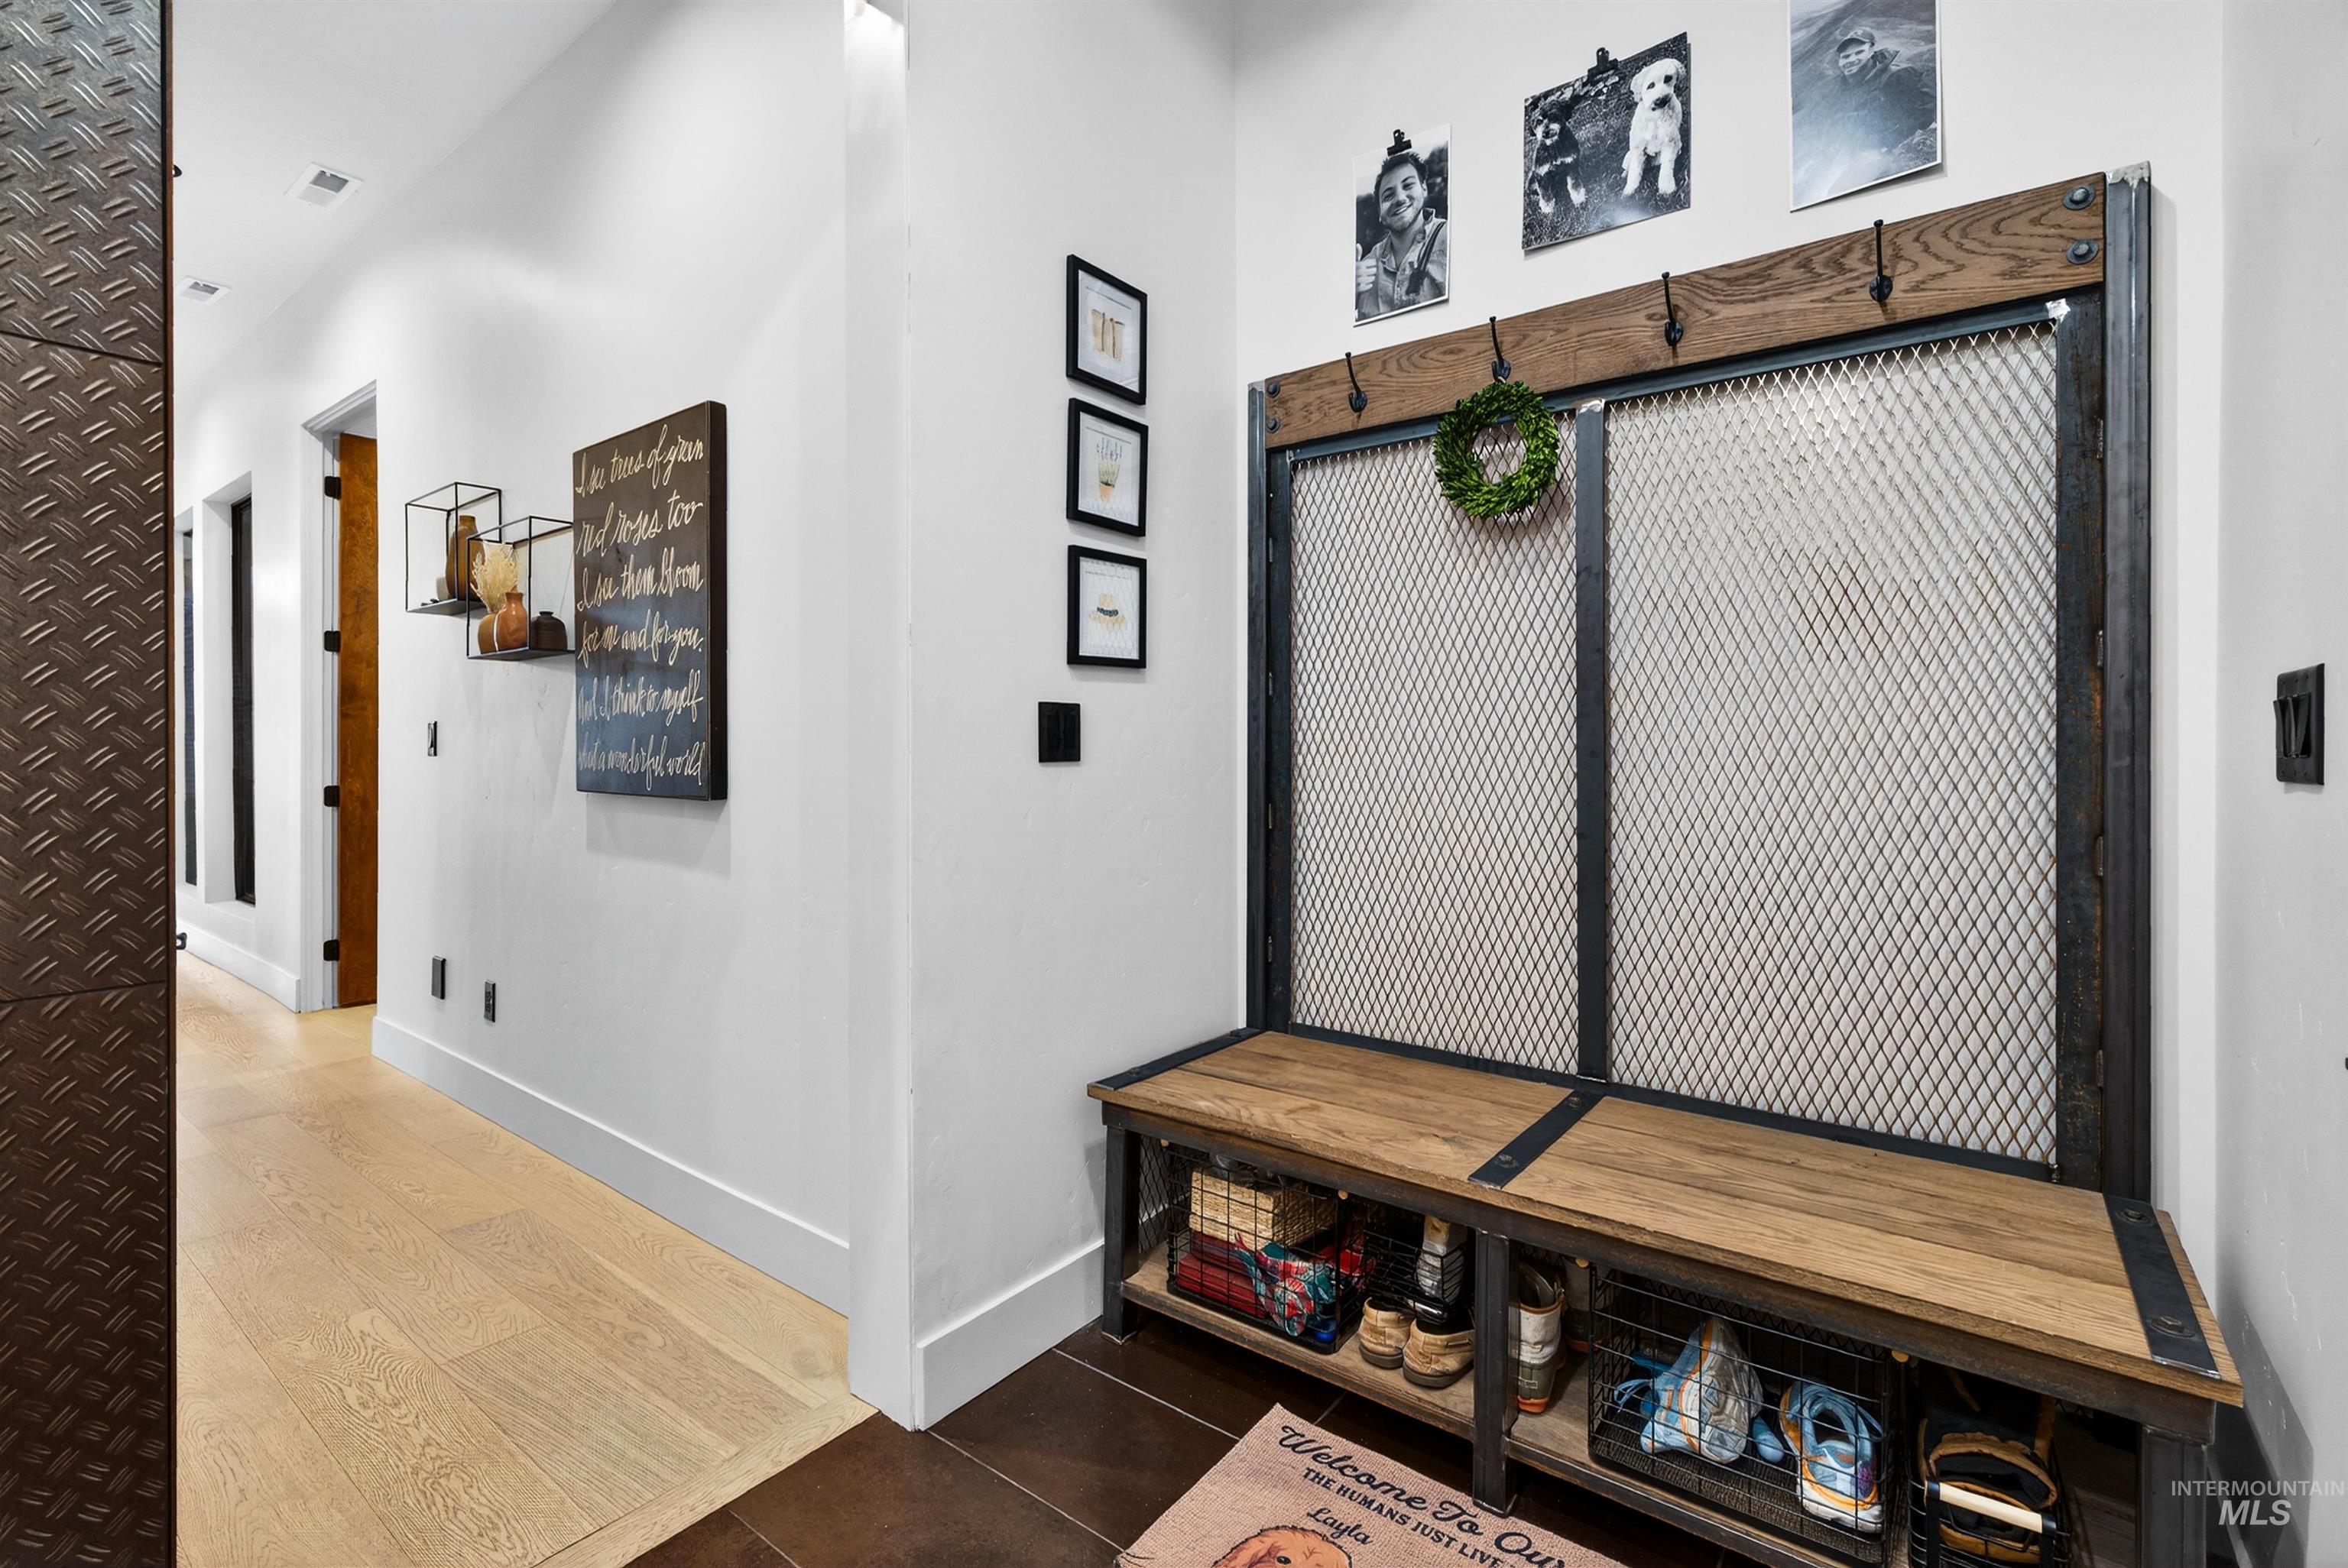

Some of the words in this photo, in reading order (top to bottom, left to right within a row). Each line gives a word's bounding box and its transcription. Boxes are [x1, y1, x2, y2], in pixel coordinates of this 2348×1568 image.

[586, 464, 606, 494] see
[611, 449, 645, 483] trees
[647, 423, 667, 490] of
[663, 435, 704, 486] green
[576, 501, 615, 557] red
[610, 510, 663, 546] roses
[667, 489, 703, 530] too
[593, 572, 619, 607] see
[621, 554, 657, 600] them
[621, 609, 651, 652] and
[612, 675, 647, 718] think
[656, 669, 703, 727] myself
[607, 734, 668, 791] wonderful
[666, 740, 705, 786] world
[1279, 1425, 1428, 1511] Welcome
[1432, 1500, 1484, 1536] To
[1303, 1466, 1336, 1490] THE
[1336, 1484, 1411, 1525] HUMANS
[1411, 1521, 1458, 1549] JUST
[1306, 1508, 1373, 1545] Layla
